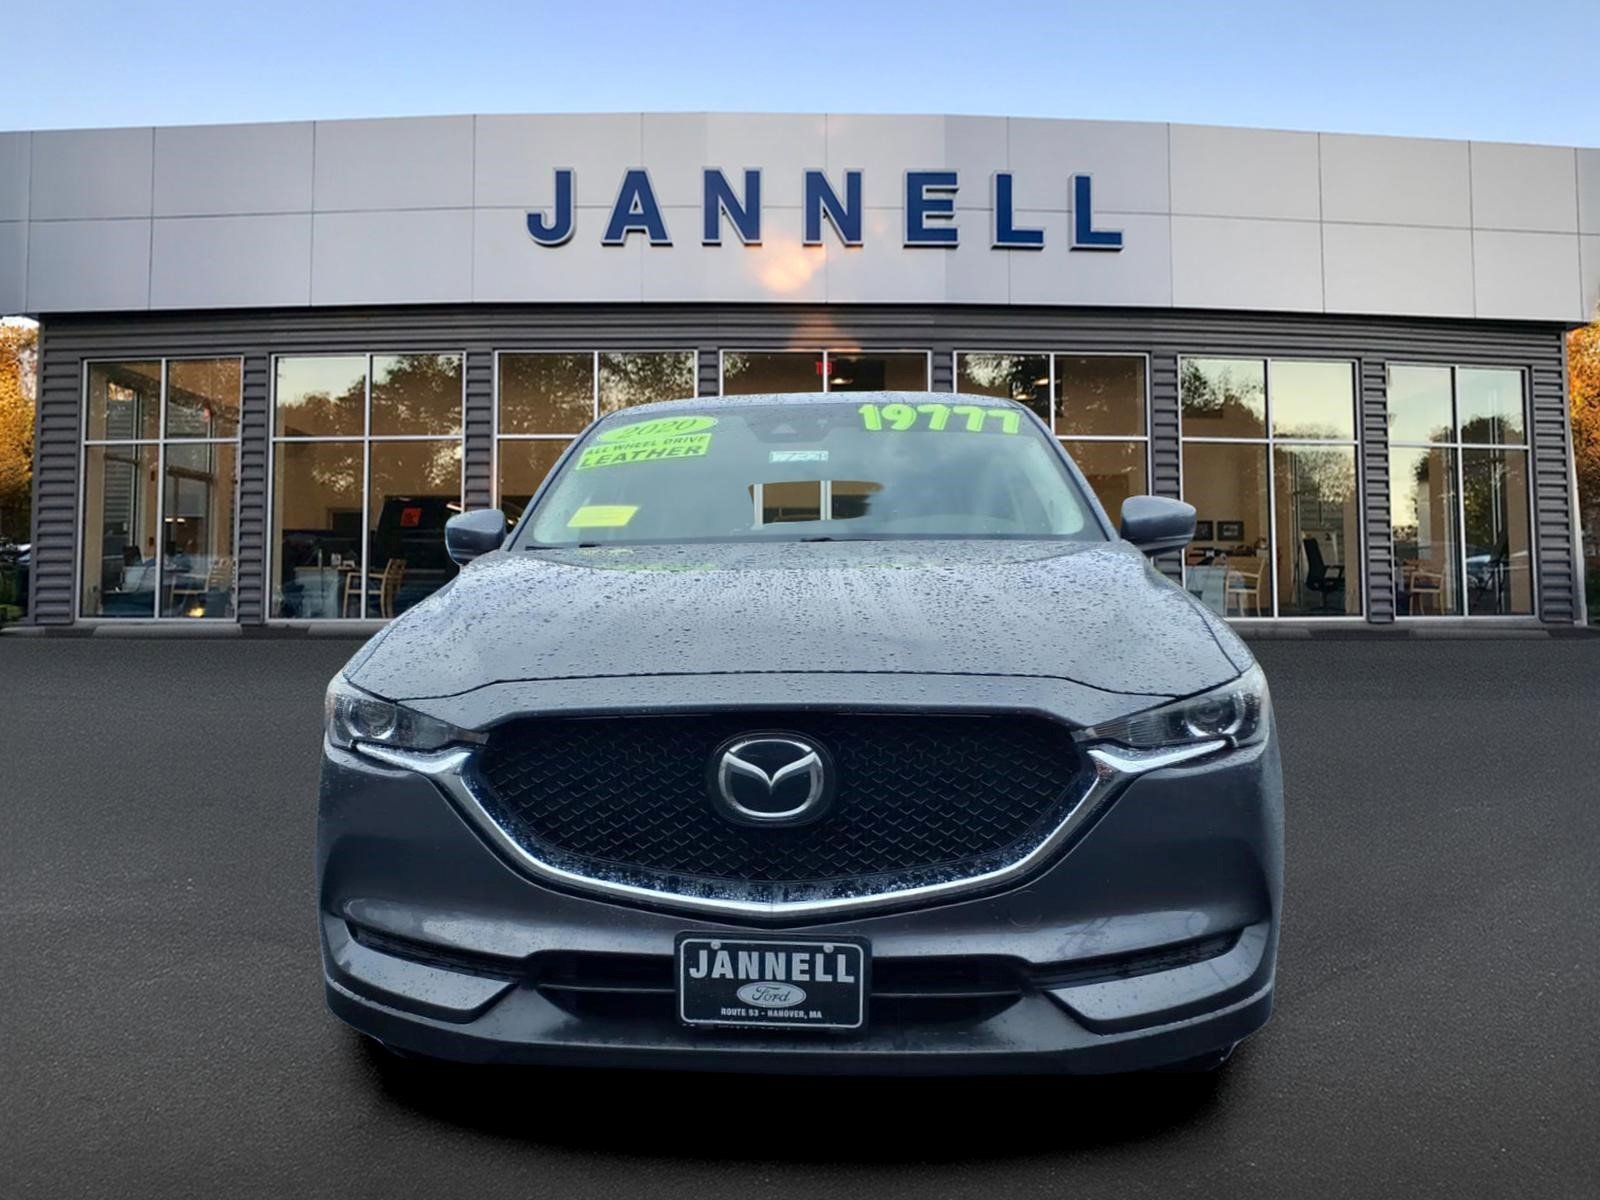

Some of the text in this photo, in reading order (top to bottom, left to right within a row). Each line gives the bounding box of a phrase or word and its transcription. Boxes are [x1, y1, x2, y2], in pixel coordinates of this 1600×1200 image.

[526, 167, 1124, 249] JANNELL
[858, 403, 1020, 434] 19777
[617, 419, 697, 440] 2020
[585, 435, 705, 455] ALL WHEEL DRIVE
[580, 446, 703, 468] LEATHER
[688, 950, 855, 983] JANNELL
[752, 985, 791, 1002] Ford
[721, 1008, 746, 1016] ROUTE
[767, 1010, 807, 1019] HANOVER,
